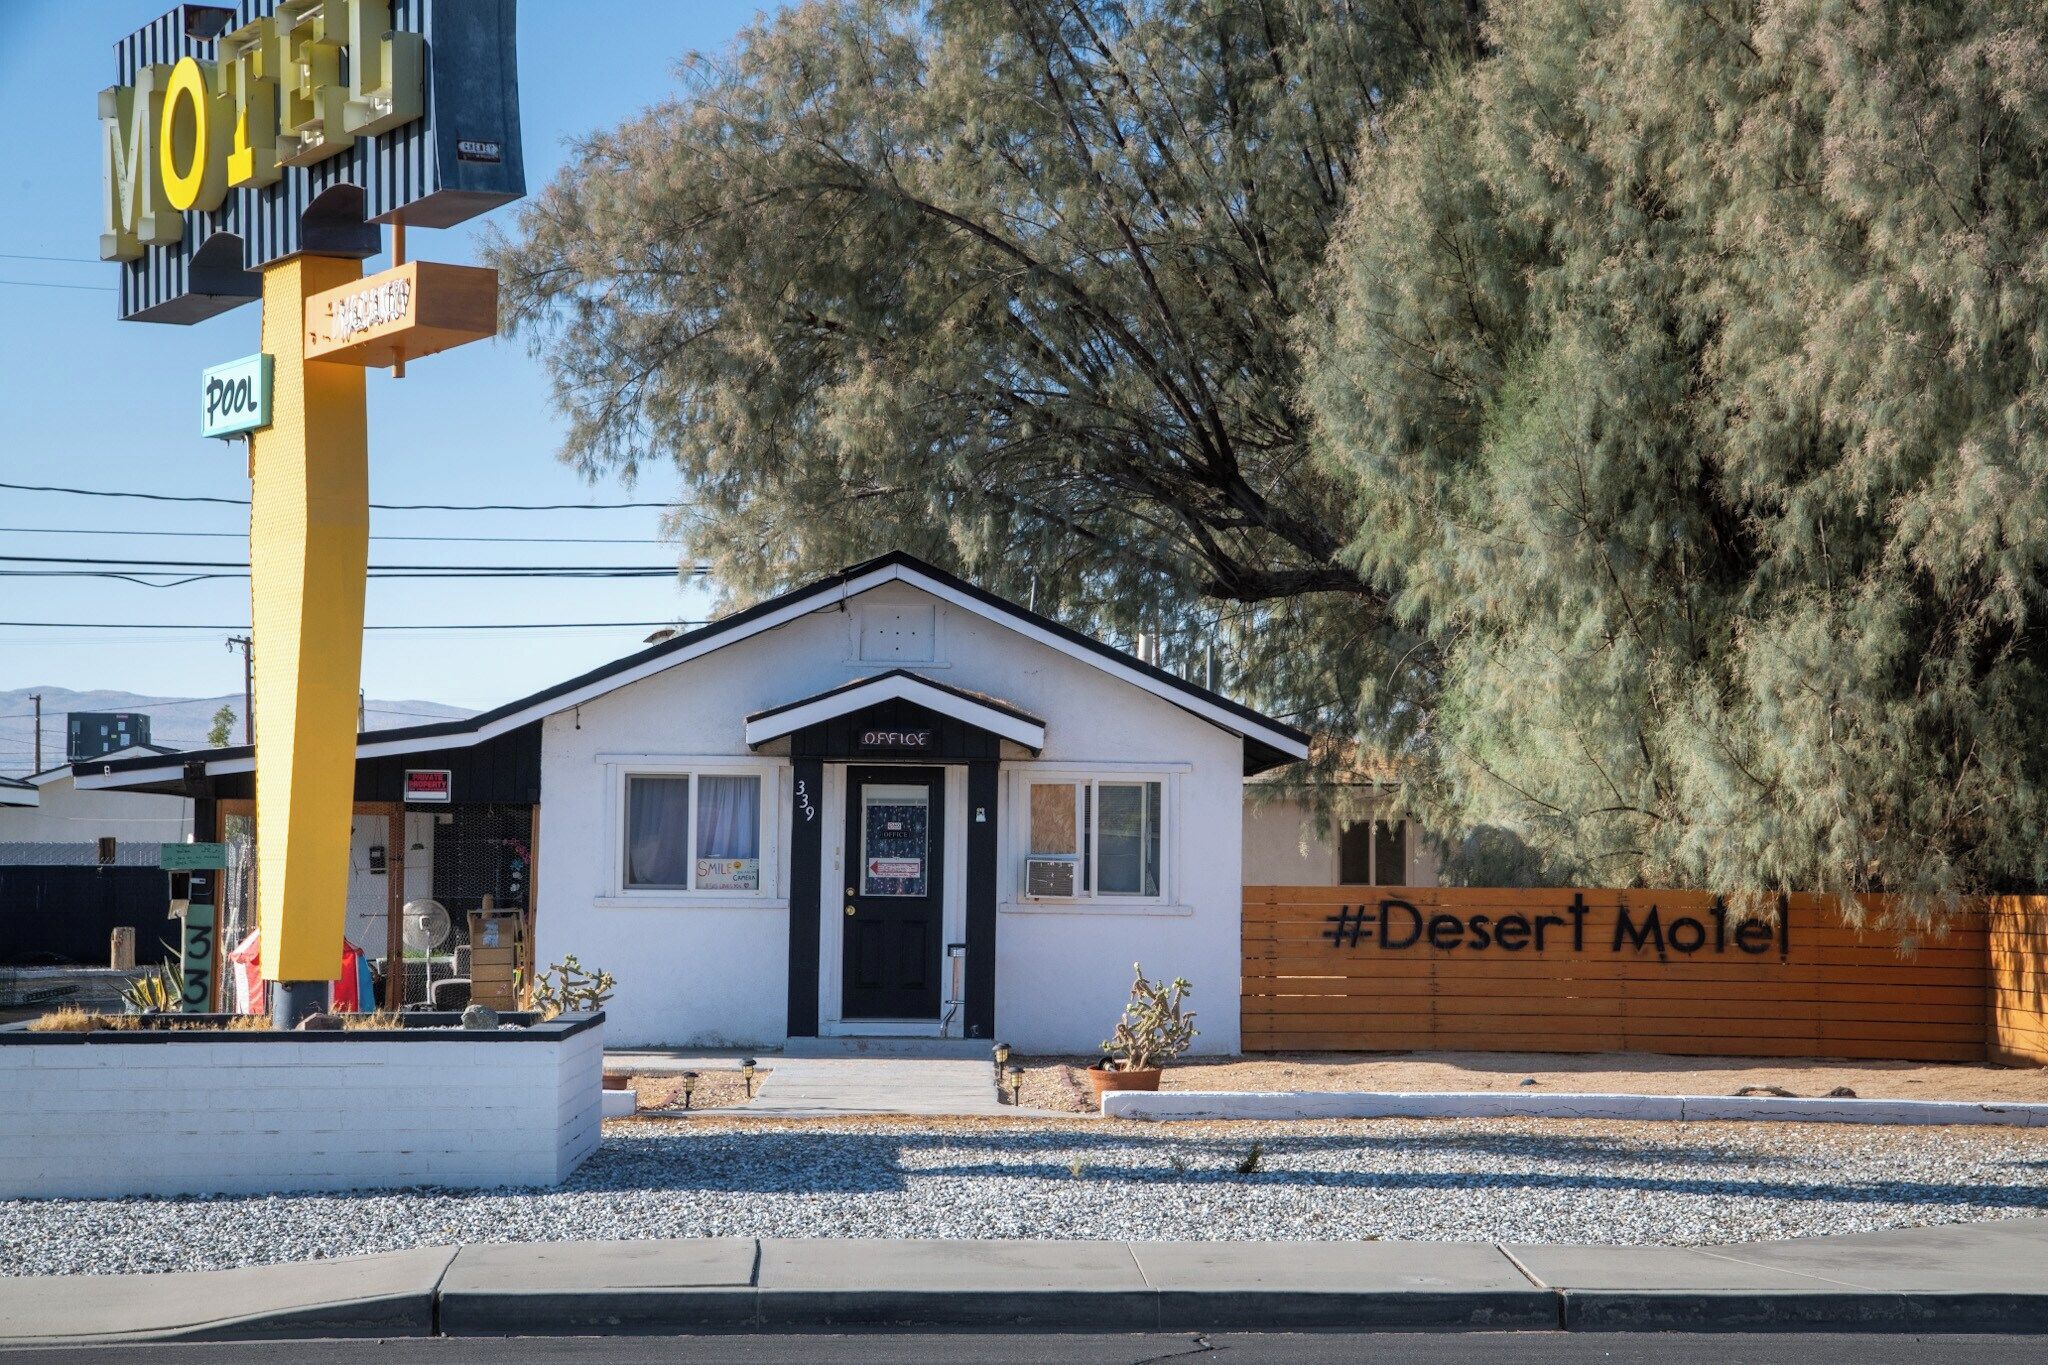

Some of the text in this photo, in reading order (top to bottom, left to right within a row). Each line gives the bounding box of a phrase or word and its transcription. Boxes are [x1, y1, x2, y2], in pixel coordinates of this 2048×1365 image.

[98, 0, 423, 261] MOTEL
[206, 375, 258, 427] POOL
[863, 732, 930, 746] OFFICE
[409, 780, 447, 788] PROPERTY
[795, 780, 815, 822] 339
[697, 860, 731, 877] SMILE
[1322, 892, 1790, 957] #Desert Motel
[183, 925, 212, 1013] 33
